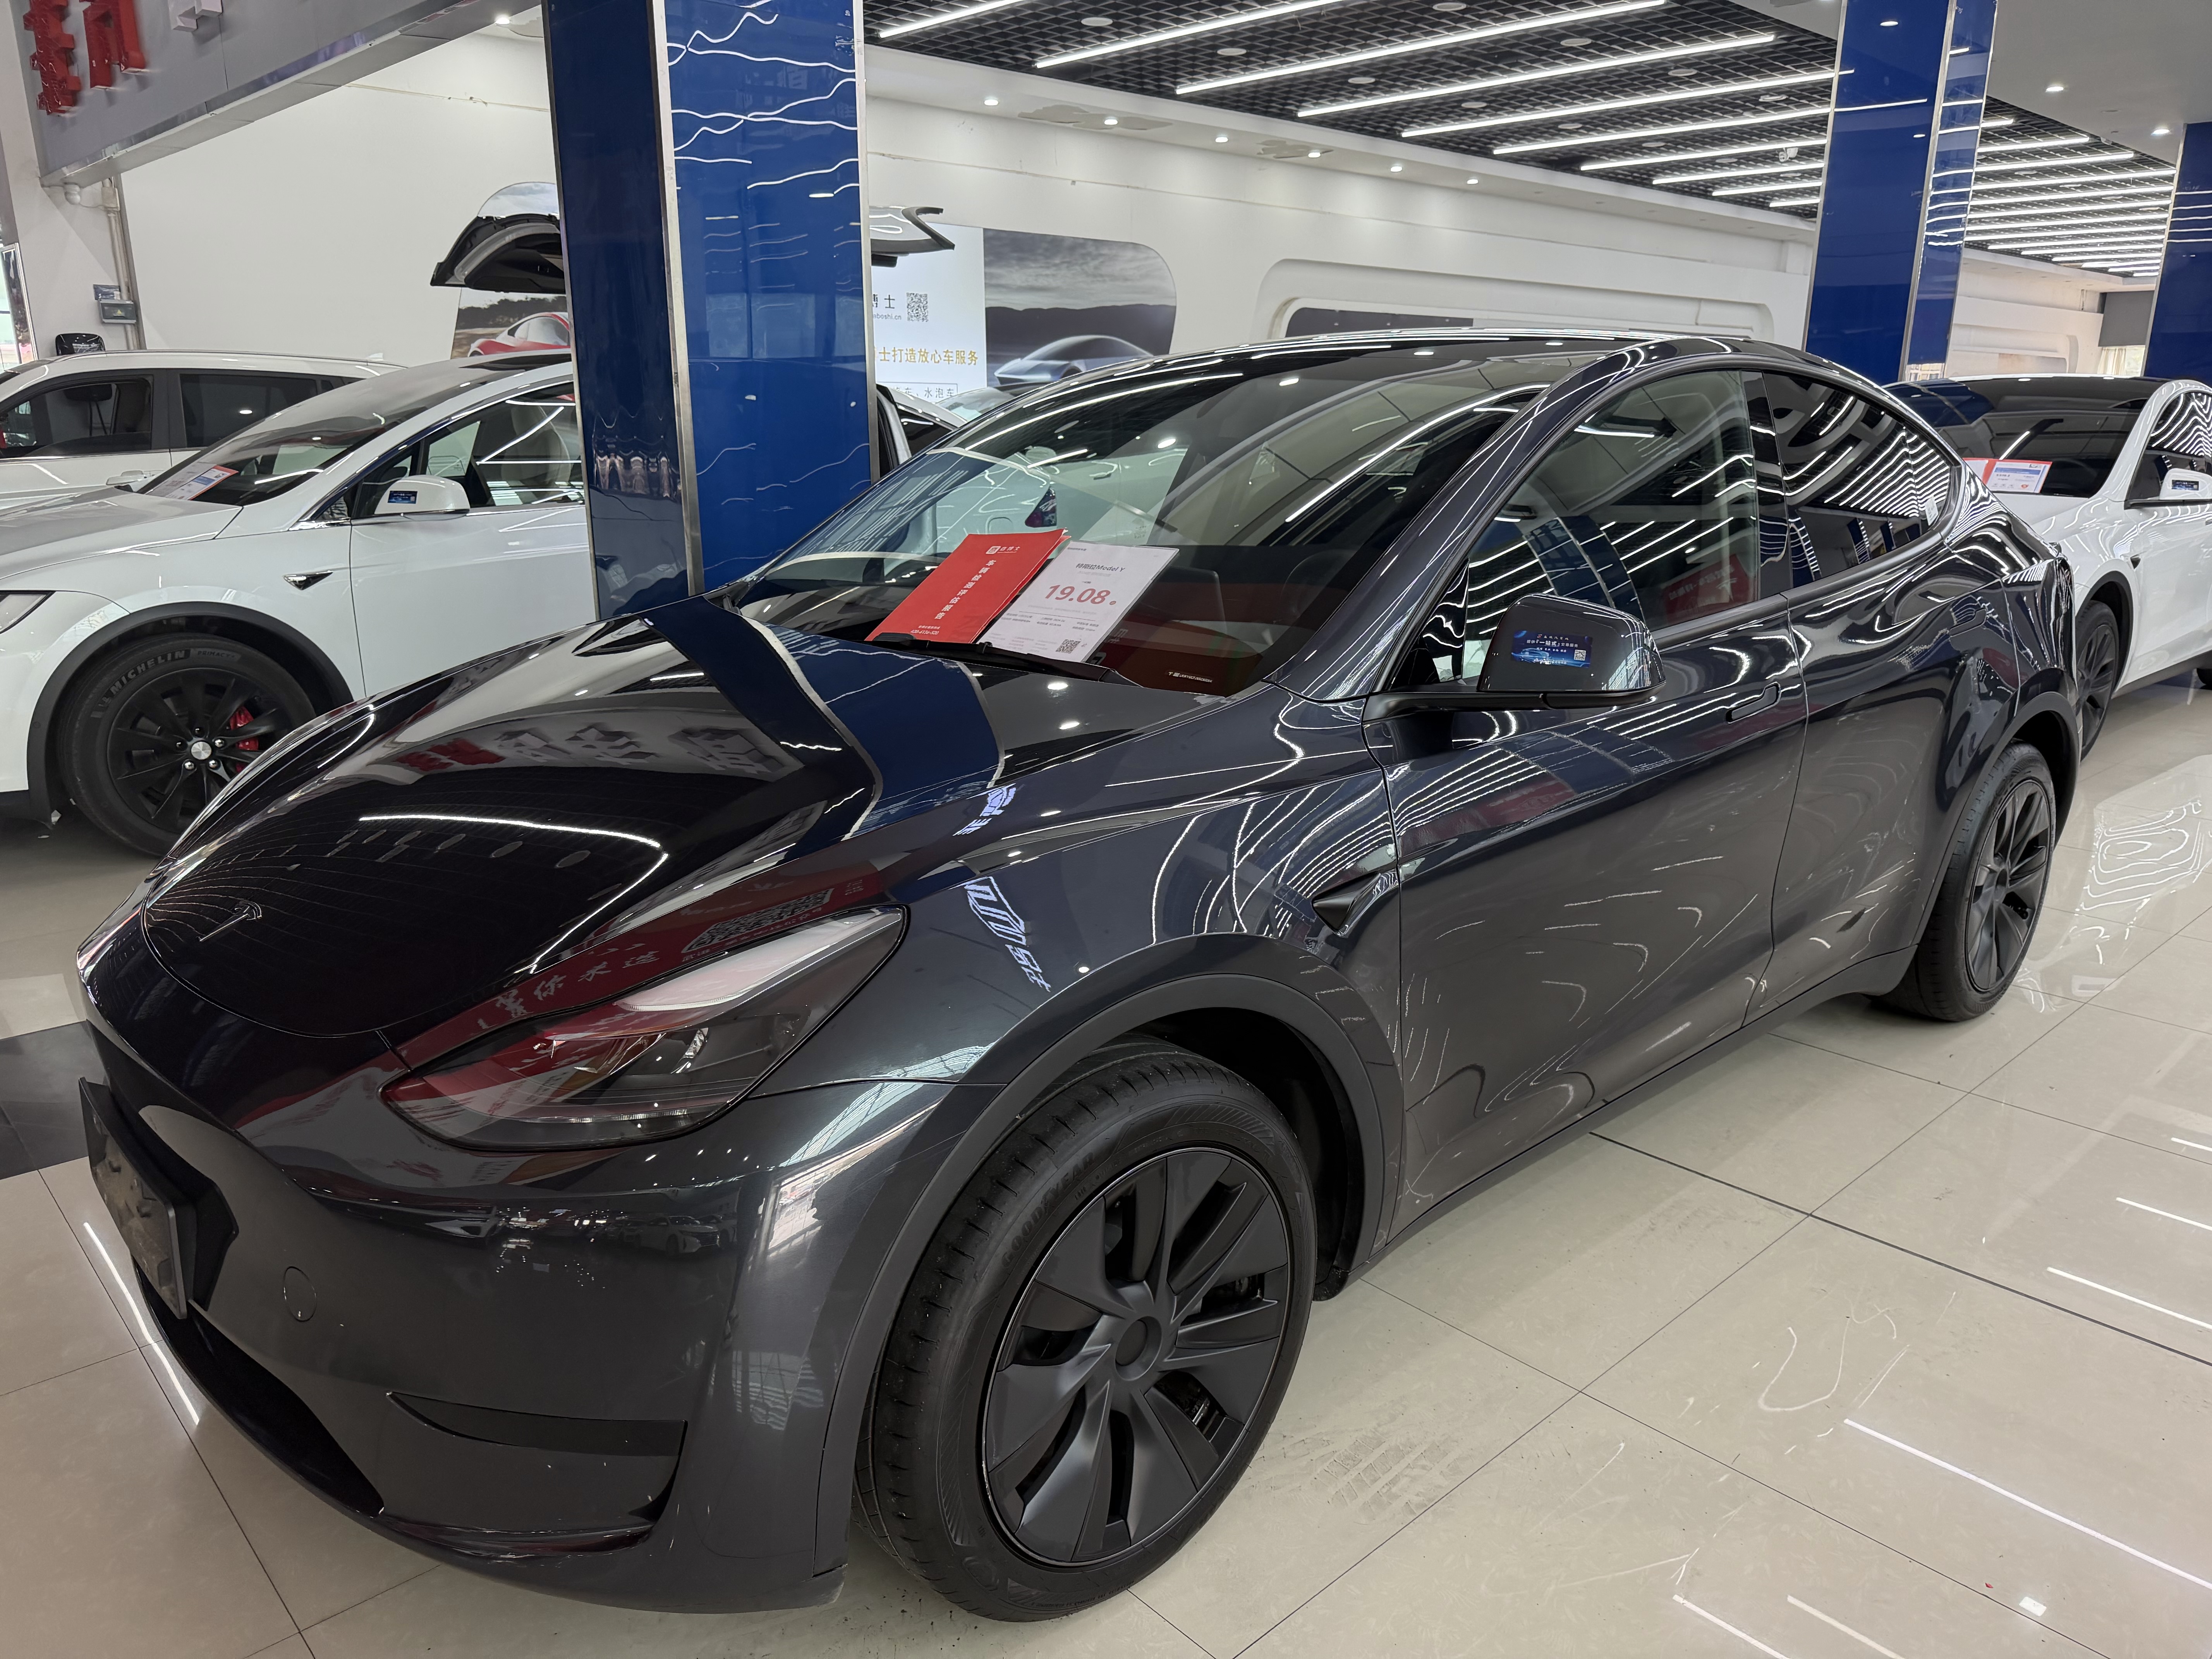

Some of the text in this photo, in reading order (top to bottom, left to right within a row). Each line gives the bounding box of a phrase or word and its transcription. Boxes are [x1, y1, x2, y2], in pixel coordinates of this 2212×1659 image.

[874, 347, 978, 365] 士打造放心车服务
[1045, 585, 1111, 604] 19.08
[110, 650, 185, 696] MICHELIN
